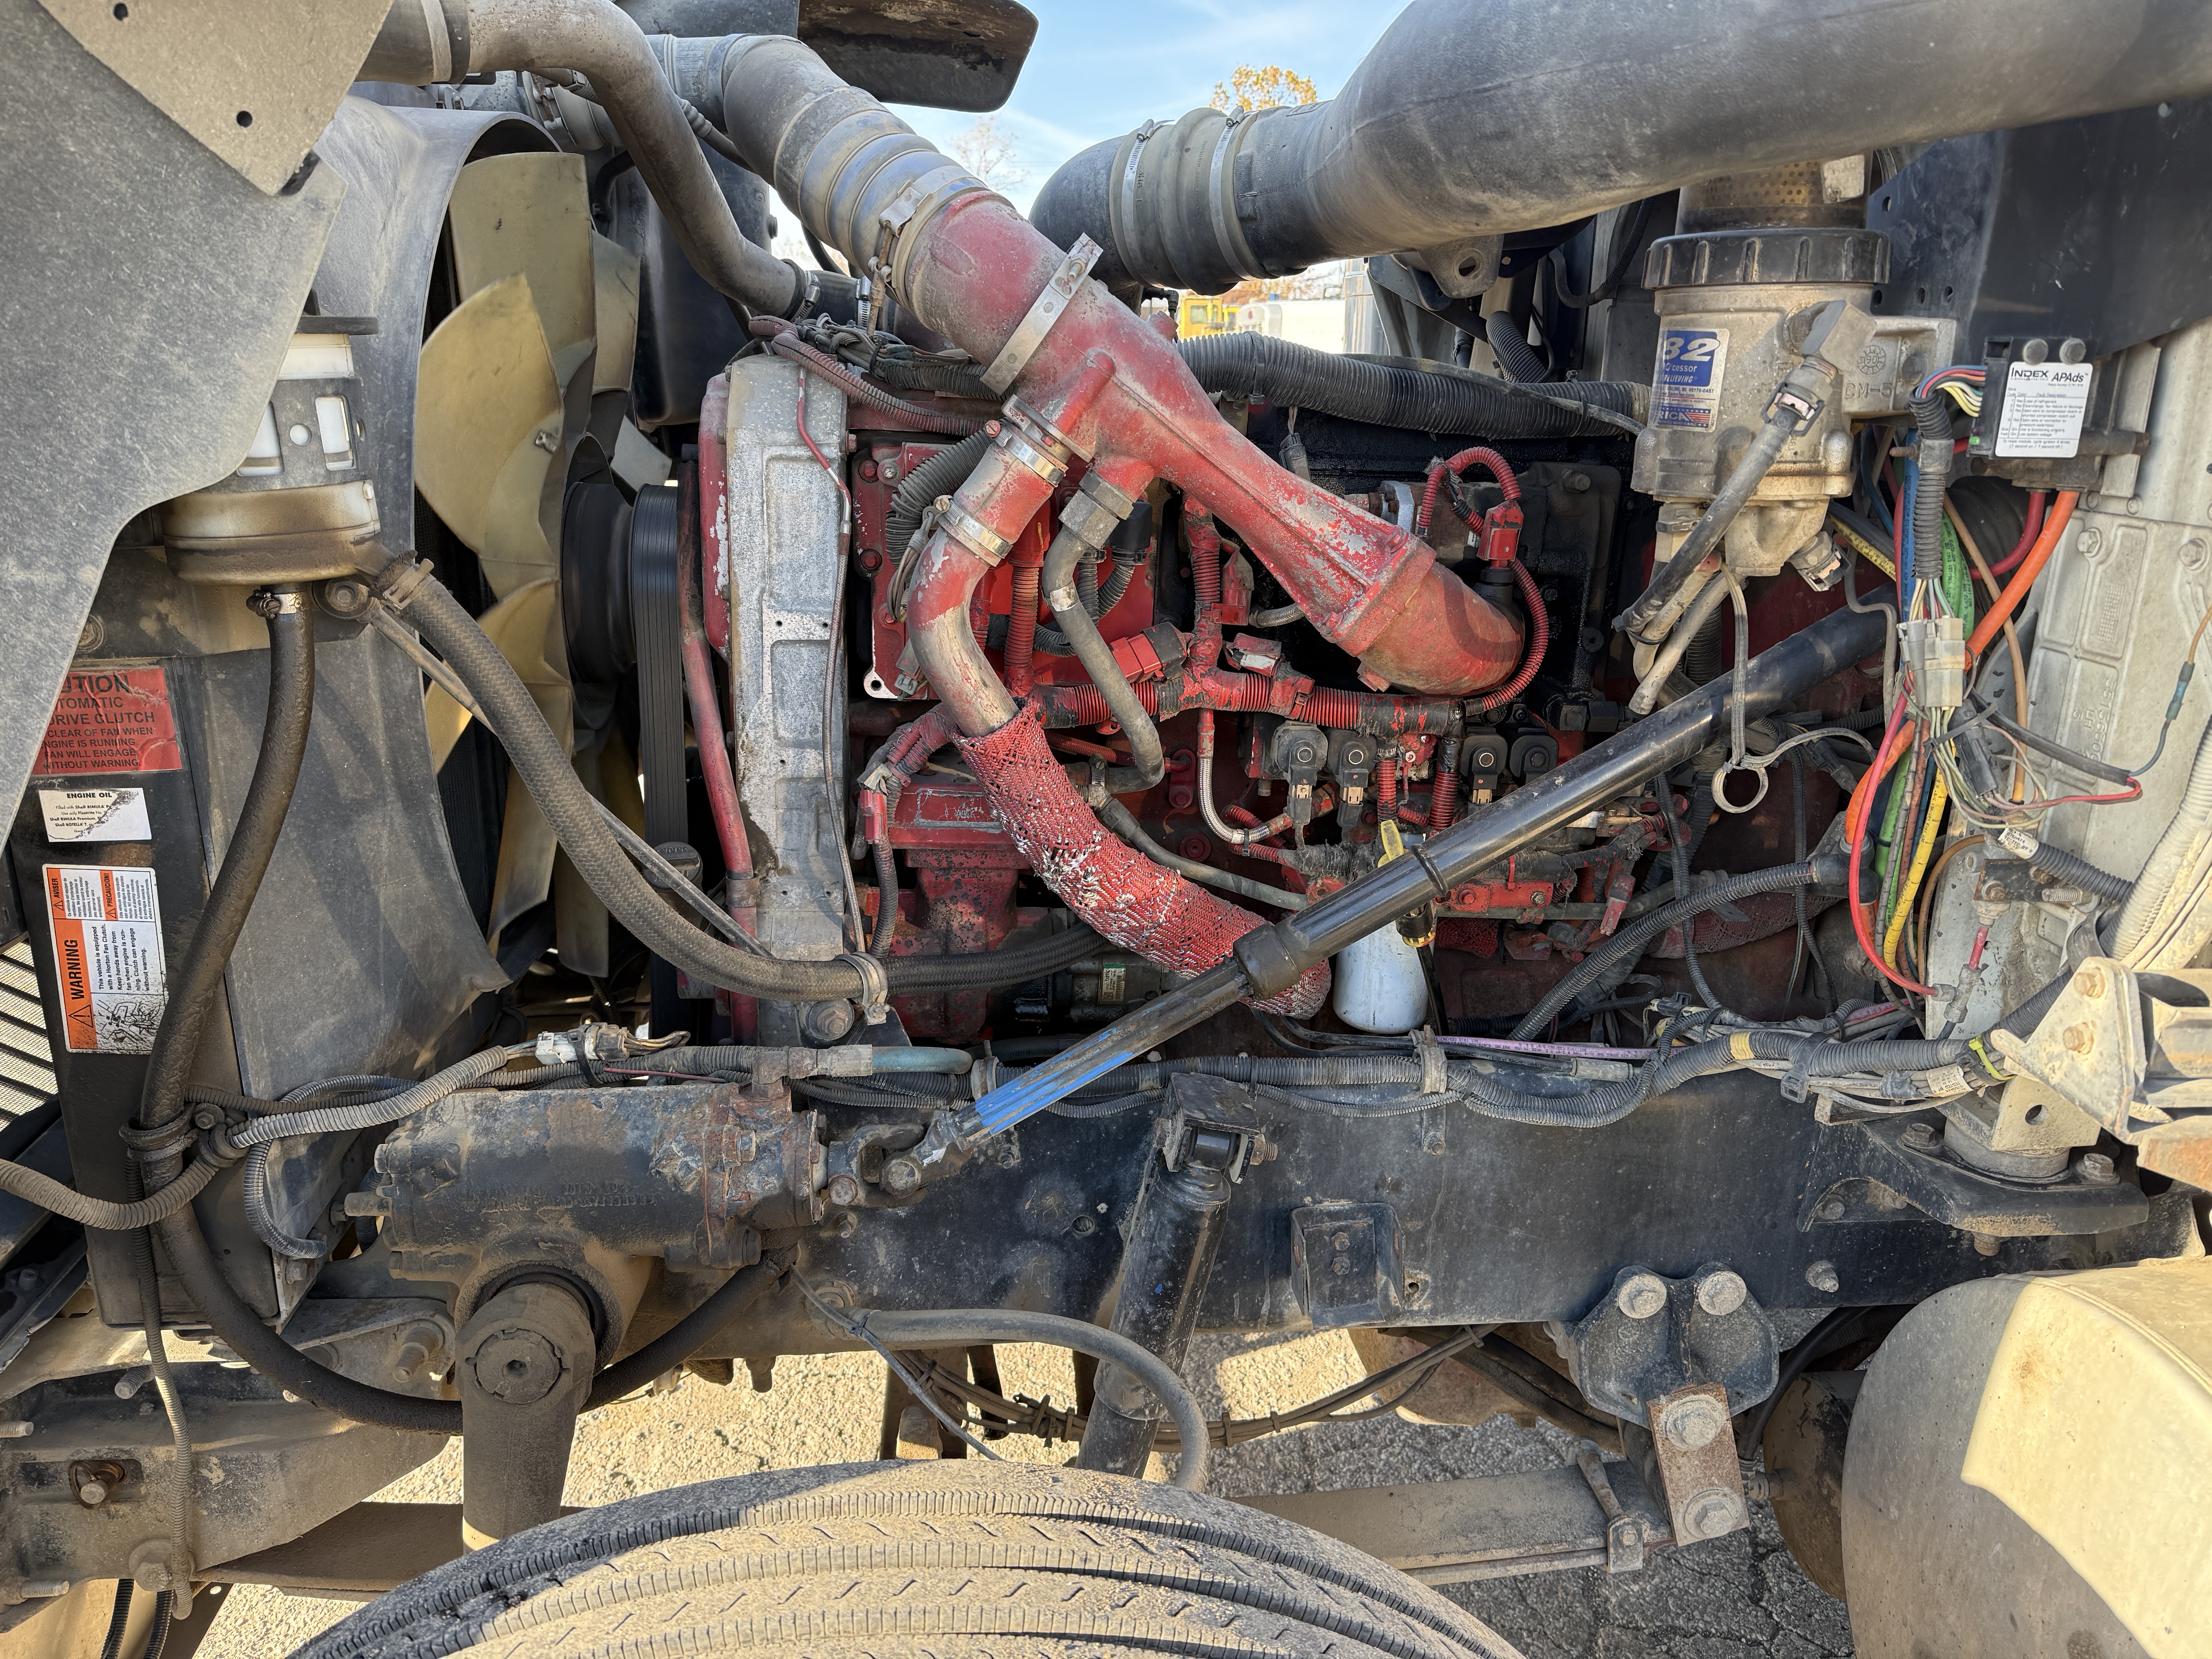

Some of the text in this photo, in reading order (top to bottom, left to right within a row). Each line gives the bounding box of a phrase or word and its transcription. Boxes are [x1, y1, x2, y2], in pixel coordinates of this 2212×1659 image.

[2011, 368, 2049, 377] INDEX
[1845, 383, 1893, 398] CM-5
[94, 712, 154, 724] CLUTCH
[48, 729, 81, 737] CLEAR
[89, 738, 138, 747] RUNNING.
[93, 749, 136, 757] ENGAGE
[91, 759, 141, 767] WARNING.
[51, 878, 60, 898] AVISER
[91, 926, 100, 950] equipped
[122, 948, 130, 965] engine
[140, 948, 149, 969] warning.
[64, 940, 84, 998] WARNING
